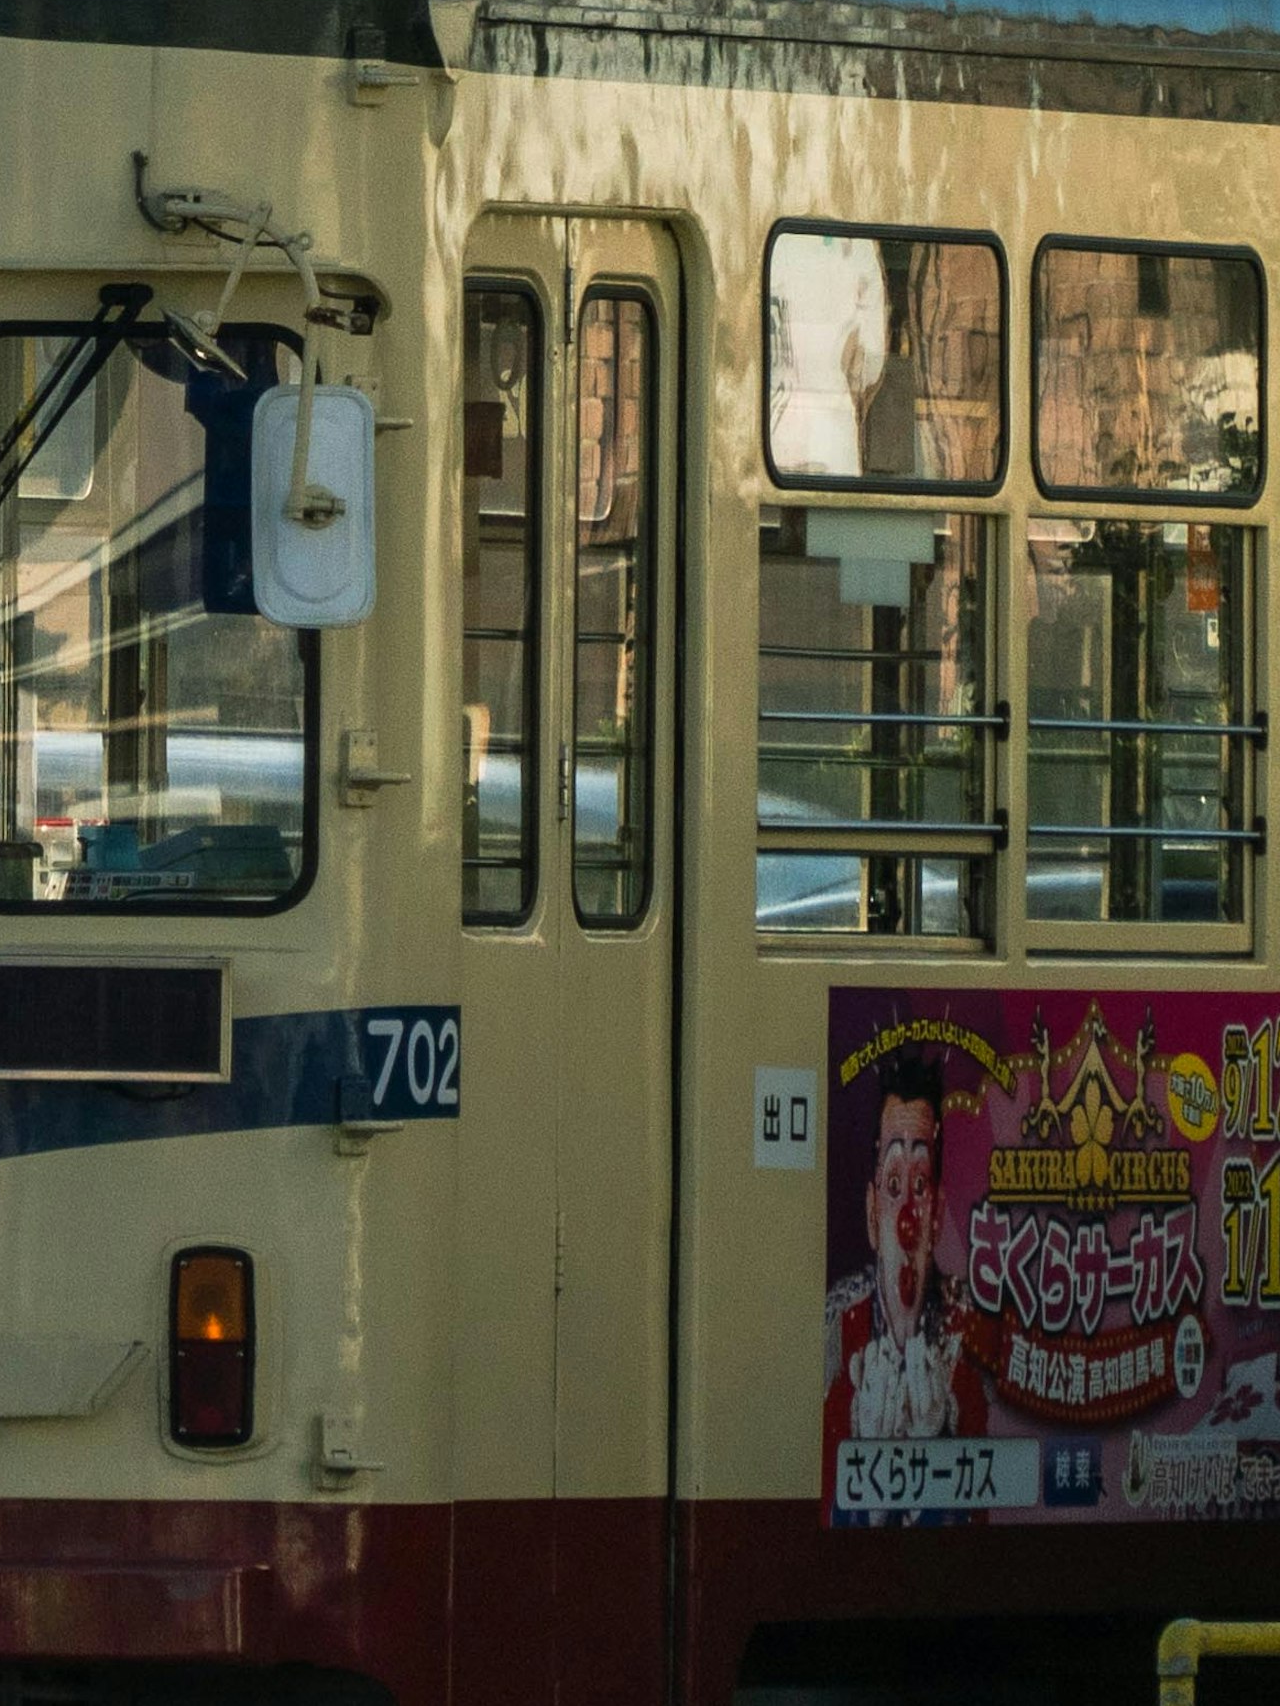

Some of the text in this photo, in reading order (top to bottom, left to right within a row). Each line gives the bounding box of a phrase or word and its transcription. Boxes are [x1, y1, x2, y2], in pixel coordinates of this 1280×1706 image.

[367, 1017, 459, 1106] 702
[763, 1094, 808, 1141] 出口
[989, 1149, 1191, 1192] SAKURA CIRCUS
[970, 1200, 1204, 1335] さくらサーカス
[1007, 1333, 1087, 1404] 高知公演
[846, 1447, 1091, 1501] さくらサーカス 検索
